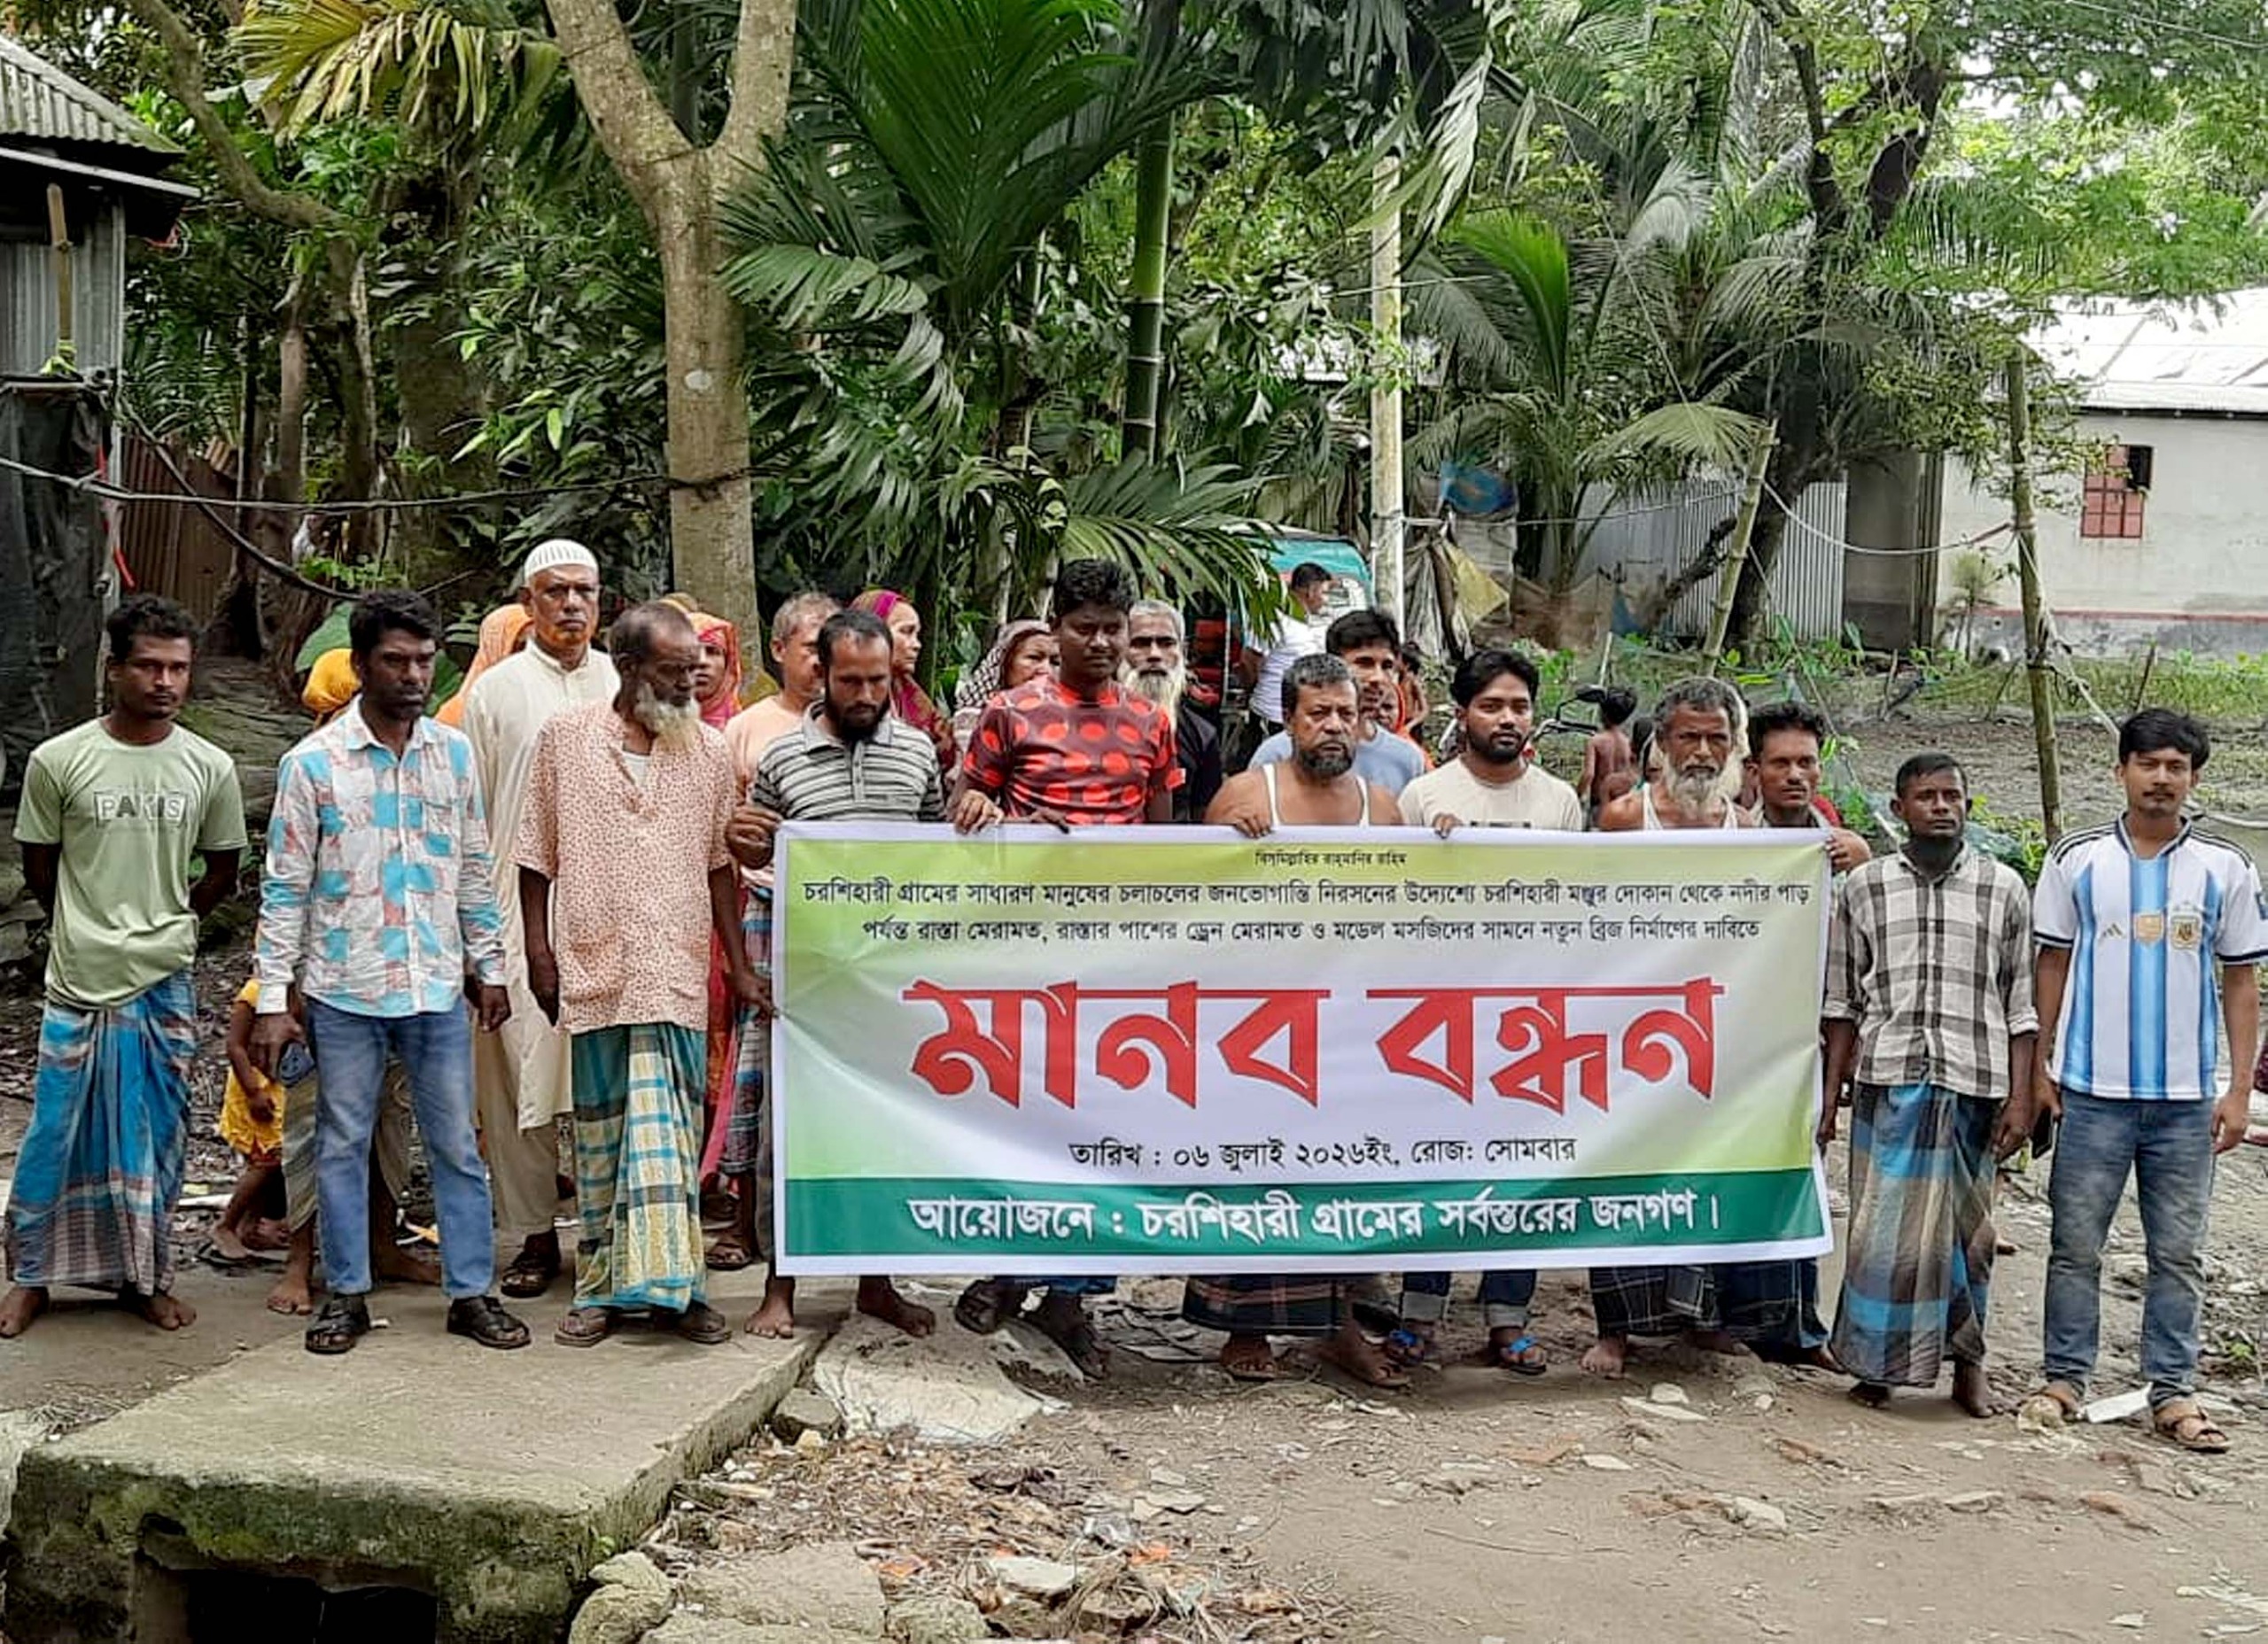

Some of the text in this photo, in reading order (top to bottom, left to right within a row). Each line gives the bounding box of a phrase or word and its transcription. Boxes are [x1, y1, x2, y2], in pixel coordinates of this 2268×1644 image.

[802, 876, 893, 905] চরশিহারী
[897, 881, 959, 904] গ্রামের
[965, 882, 1036, 904] সাধারণ
[1041, 883, 1112, 908] মানুষের
[1117, 883, 1201, 904] চলাচলের
[1207, 879, 1311, 904] জনভোগান্তি
[1317, 878, 1398, 904] নিরসনের
[1482, 878, 1562, 905] চরশিহারী
[1615, 884, 1674, 904] দোকান
[1680, 884, 1724, 904] থেকে
[1728, 878, 1772, 903] নদীর
[1777, 884, 1811, 905] পাড়
[862, 914, 1760, 944] পর্যন্ত রাস্তা মেরামত, রাস্তার পাশের ড্রেন মেরামত ও মডেল মসজিদের সামনে নতুন ব্রিজ নির্মাণের দাবিতে
[903, 977, 1725, 1116] মানব বন্ধন
[1068, 1136, 1143, 1168] তারিখ
[1173, 1144, 1210, 1168] ০৬
[1218, 1136, 1287, 1173] জুলাই
[1410, 1138, 1473, 1165] রোজ:
[1484, 1136, 1578, 1163] সোমবার
[907, 1194, 1097, 1239] আয়োজনে
[1136, 1190, 1301, 1245] চরশিহারী
[1310, 1198, 1425, 1242] গ্রামের
[1433, 1186, 1581, 1237] সর্বস্তরের
[1592, 1189, 1698, 1232] জনগণ
